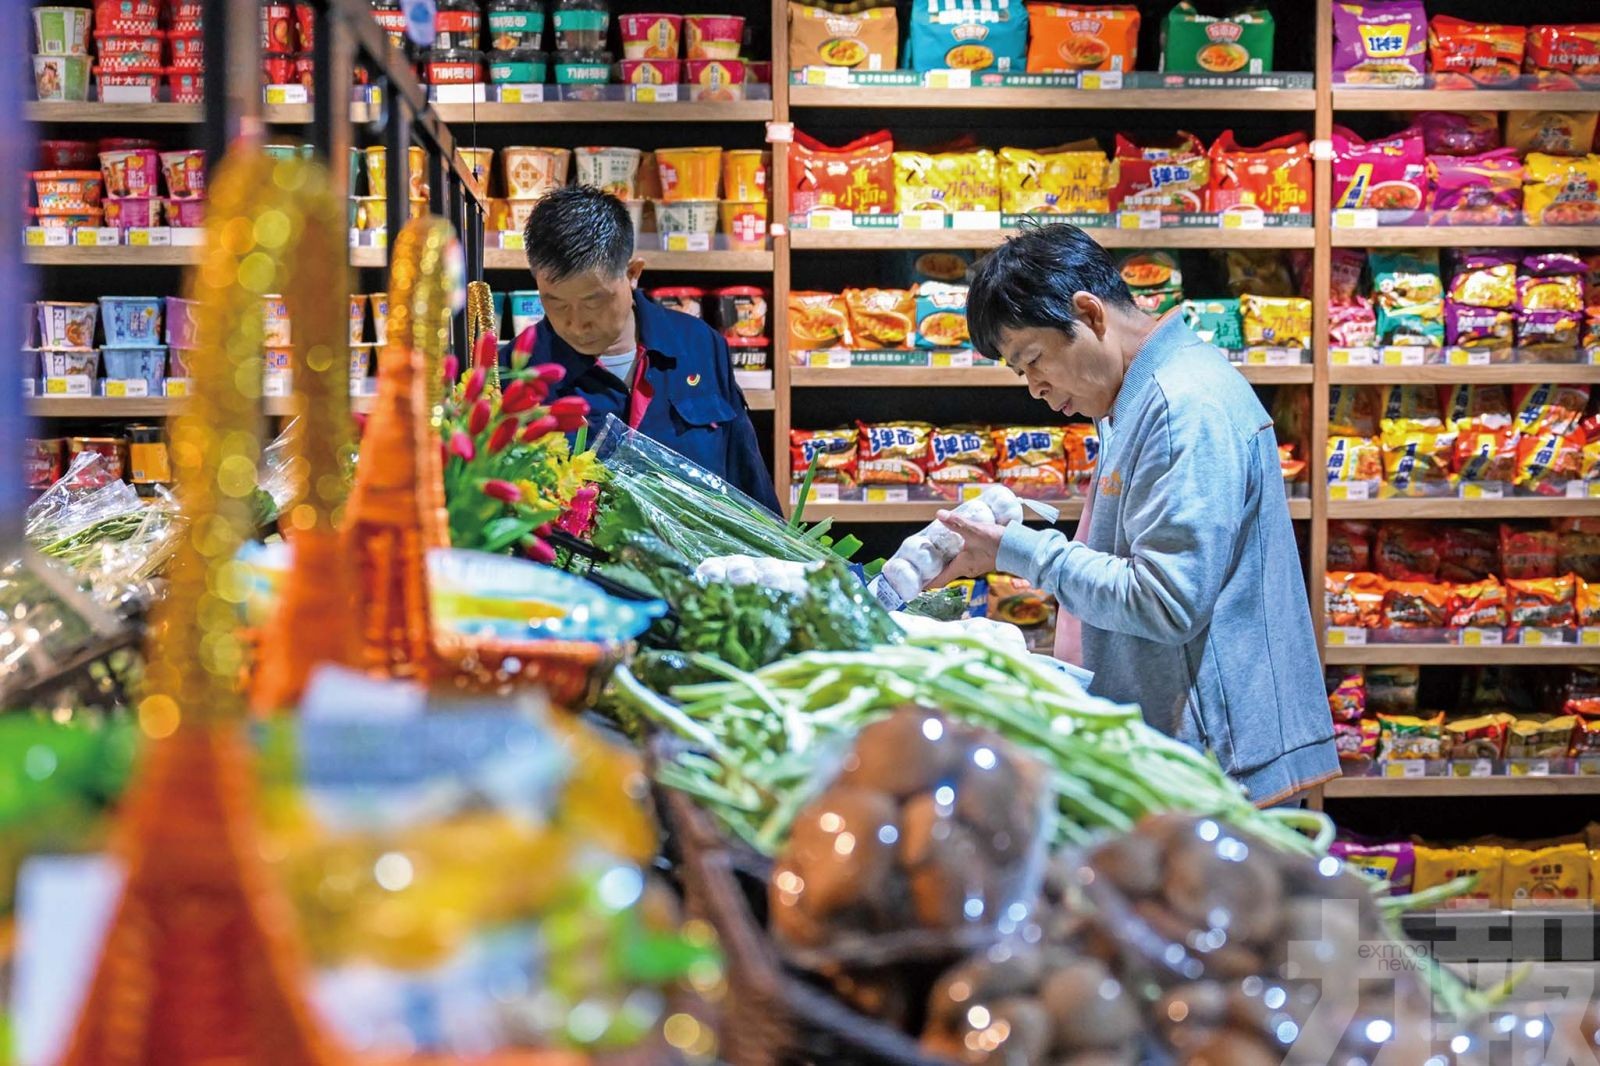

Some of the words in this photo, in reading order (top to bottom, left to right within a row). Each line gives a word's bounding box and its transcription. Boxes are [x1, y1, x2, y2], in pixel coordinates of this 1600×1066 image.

[1152, 165, 1191, 189] 弹面
[869, 428, 915, 455] 弹面
[933, 432, 981, 462] 弹面
[1006, 432, 1051, 458] 弹面
